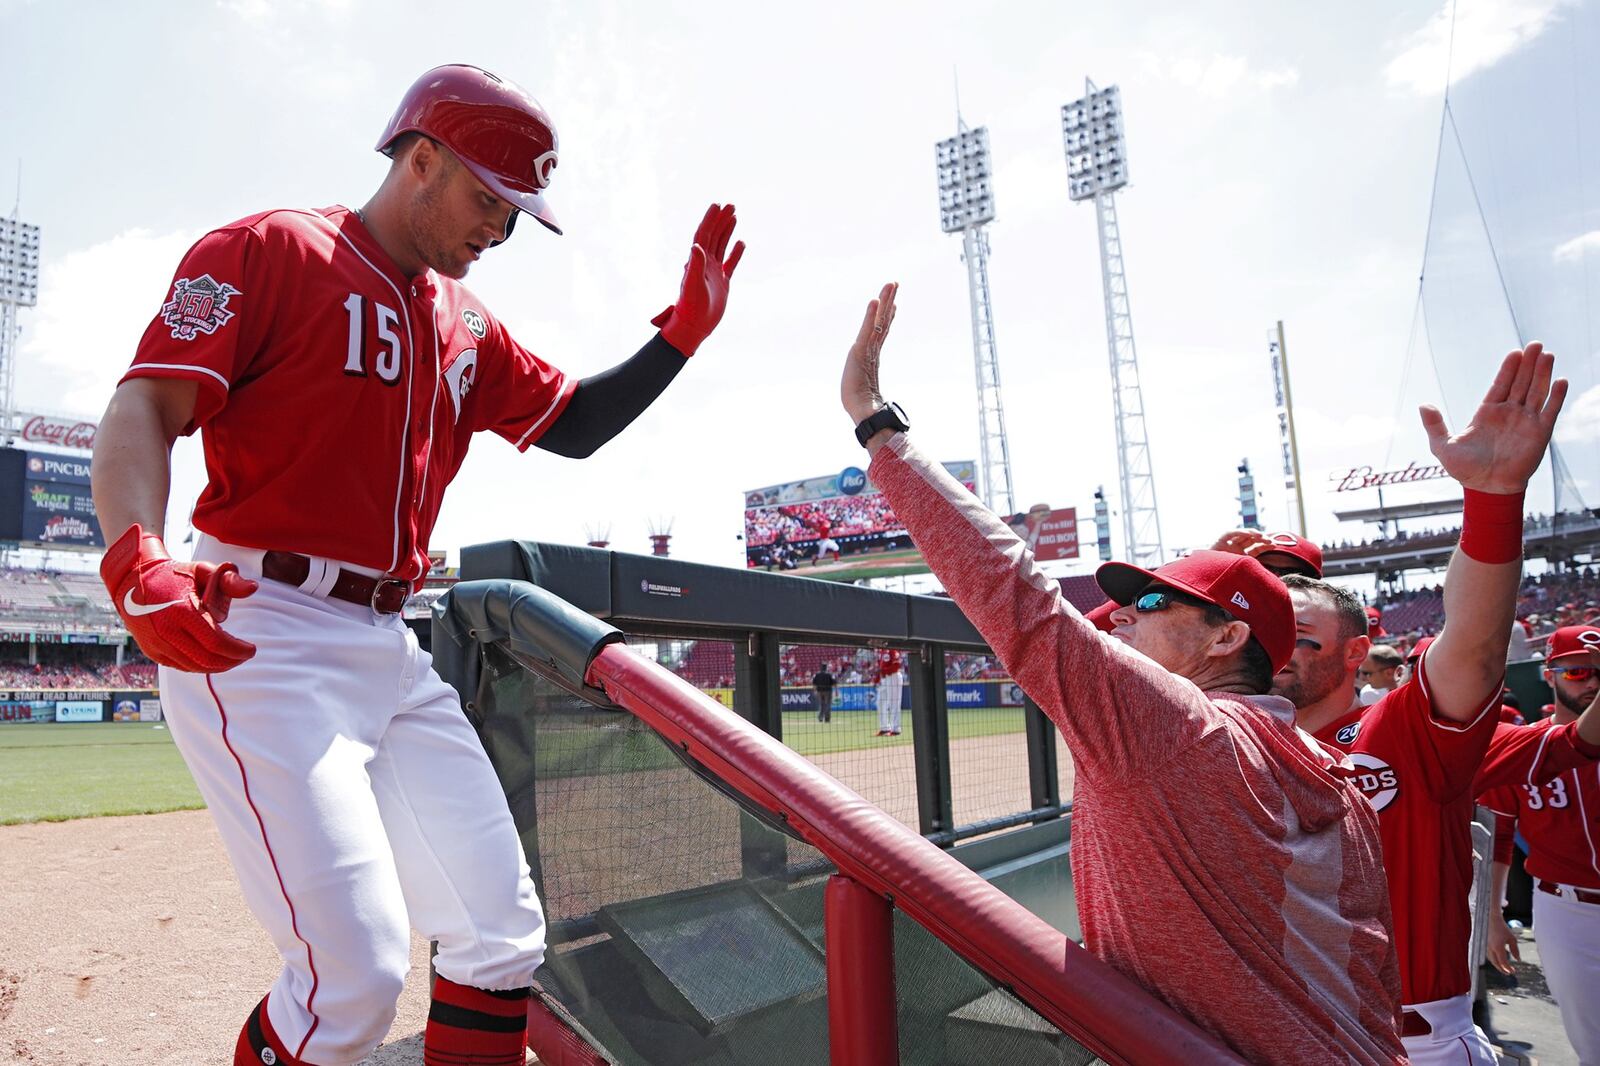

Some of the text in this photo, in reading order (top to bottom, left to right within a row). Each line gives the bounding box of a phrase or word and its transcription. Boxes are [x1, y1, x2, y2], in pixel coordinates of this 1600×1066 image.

[177, 292, 214, 320] 150
[183, 316, 214, 331] STOCKINGS
[464, 313, 483, 332] 20
[343, 293, 402, 386] 15
[23, 416, 97, 449] Coca-Col
[843, 475, 864, 487] P&G
[1328, 462, 1450, 492] Budwe
[60, 517, 80, 527] John
[39, 522, 88, 540] Morrell
[1039, 532, 1077, 545] BIG BOY
[14, 692, 41, 701] START
[43, 692, 66, 701] DEAD
[781, 693, 812, 705] BANK
[0, 703, 32, 720] UN
[1339, 726, 1358, 740] 20
[1346, 770, 1397, 792] DS
[1522, 777, 1568, 810] 33
